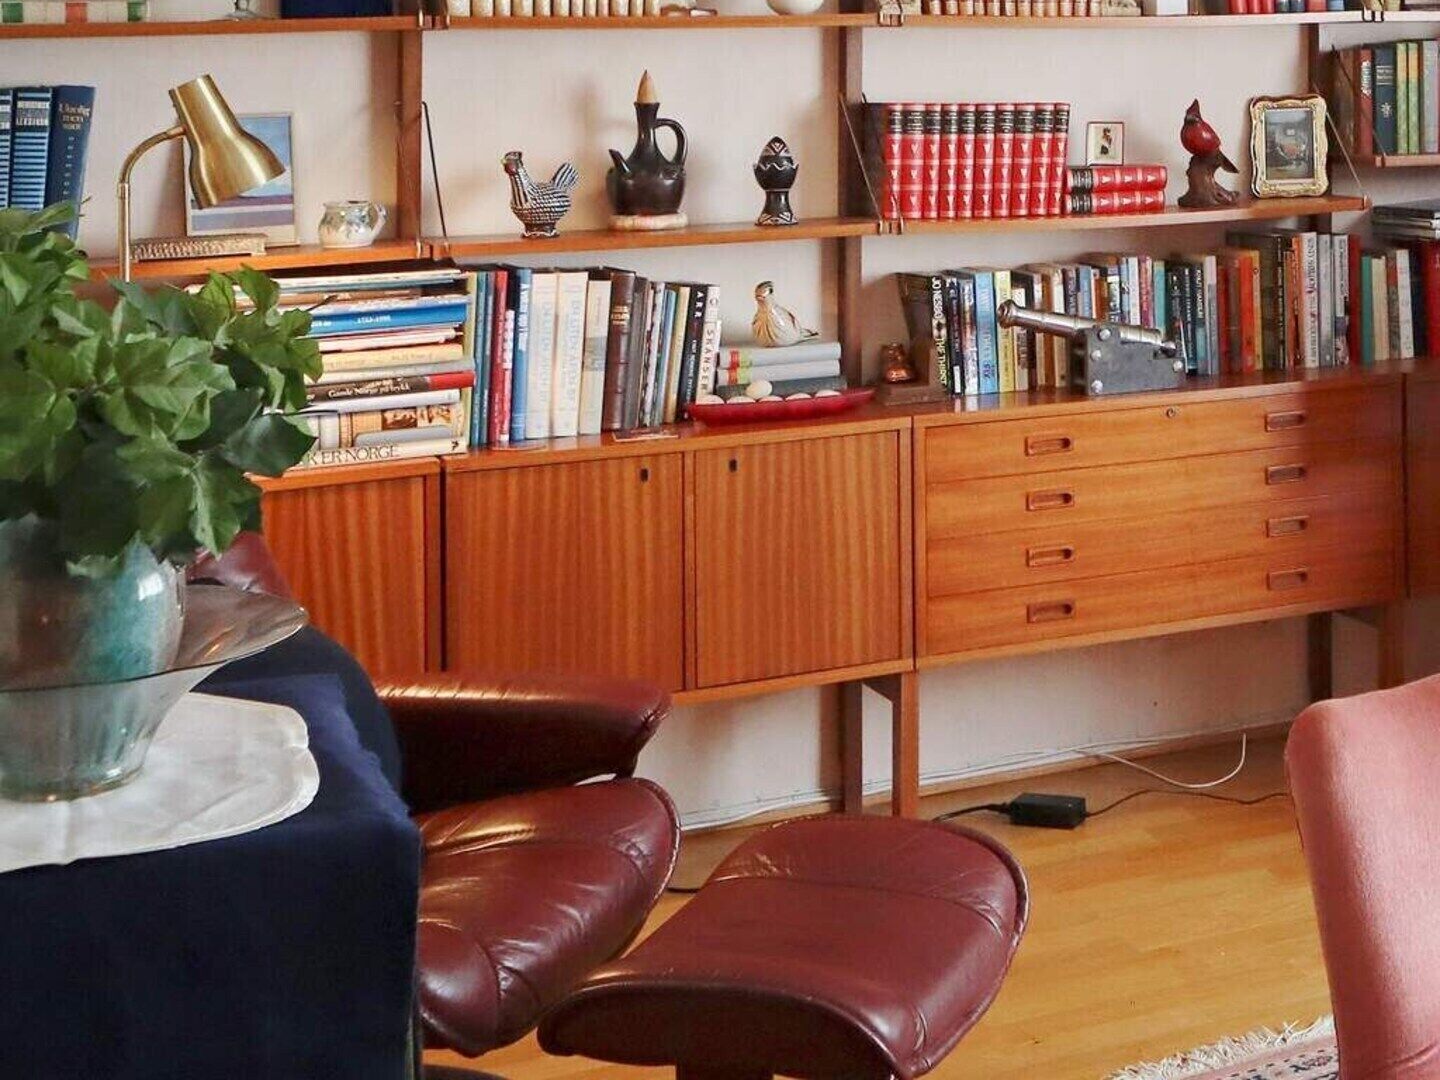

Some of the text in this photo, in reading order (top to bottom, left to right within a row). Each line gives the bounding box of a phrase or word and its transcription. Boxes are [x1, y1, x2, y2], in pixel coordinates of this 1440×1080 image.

[931, 276, 942, 289] JO
[935, 337, 948, 387] THE THIRST
[321, 449, 341, 465] ER
[345, 444, 398, 462] NORGE
